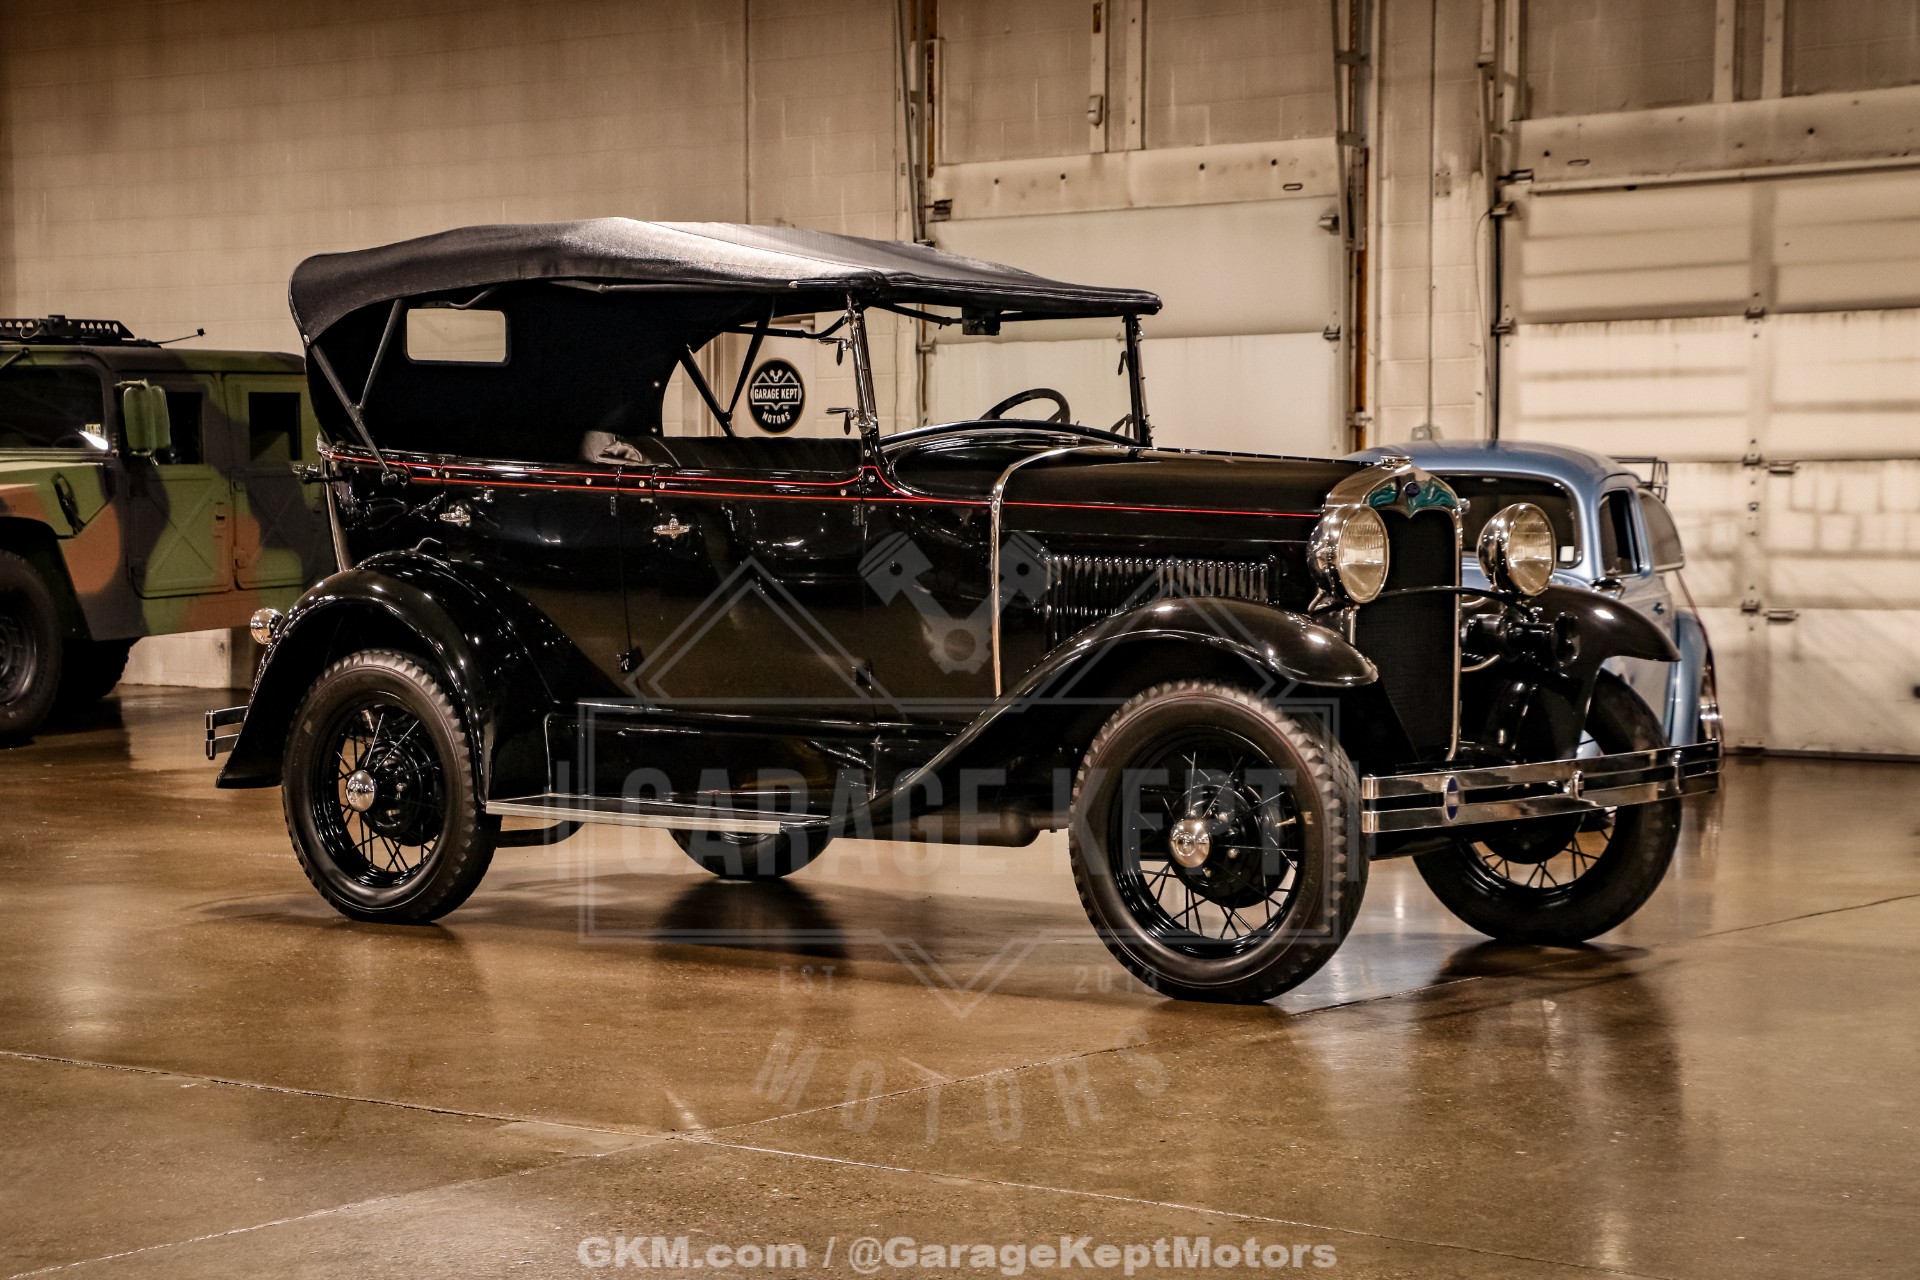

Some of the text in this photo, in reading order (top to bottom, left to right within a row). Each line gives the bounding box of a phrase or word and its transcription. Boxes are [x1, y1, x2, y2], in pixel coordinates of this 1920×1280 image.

[754, 388, 798, 399] GARAGE KEPT
[762, 411, 791, 424] MOTORS
